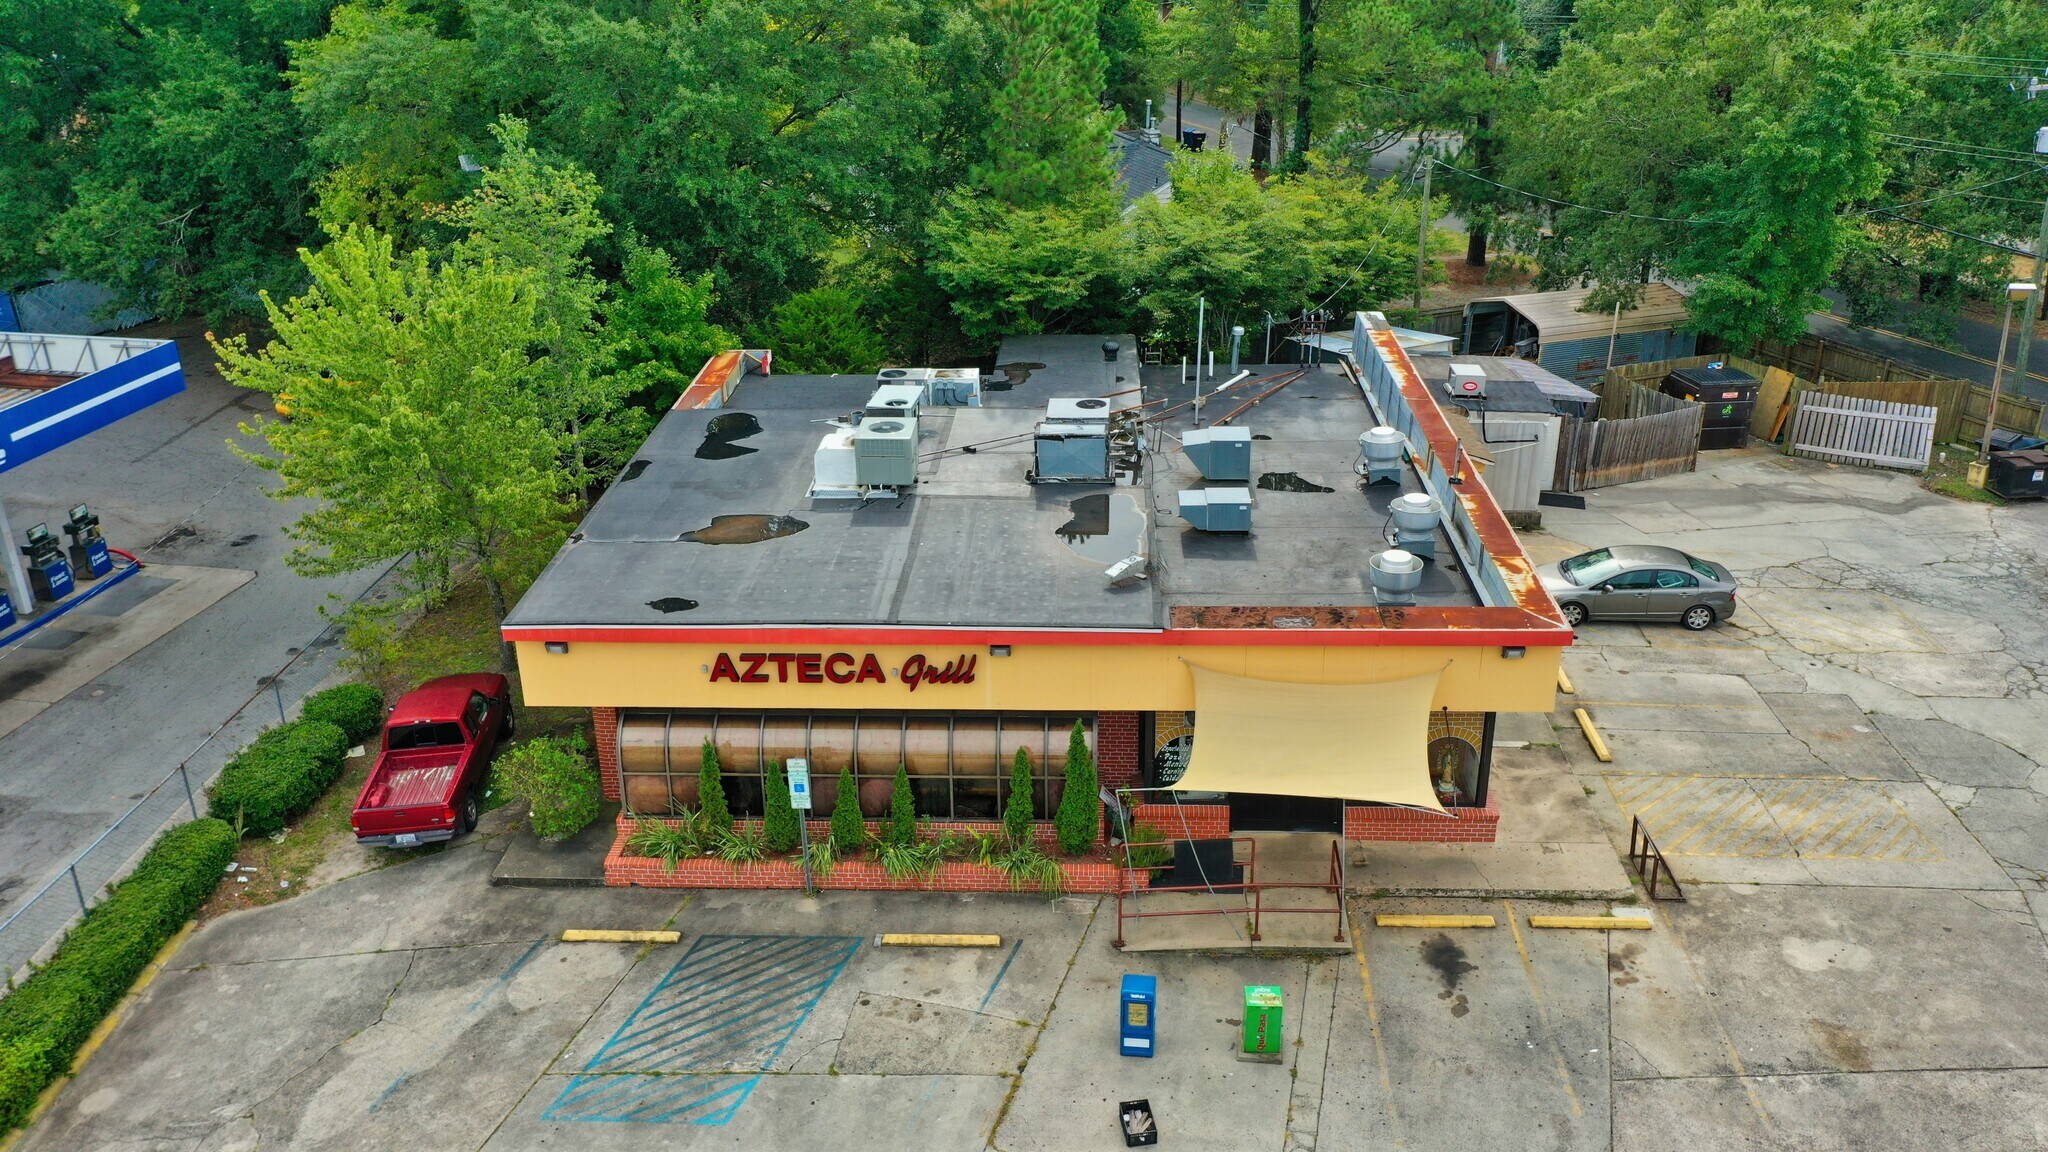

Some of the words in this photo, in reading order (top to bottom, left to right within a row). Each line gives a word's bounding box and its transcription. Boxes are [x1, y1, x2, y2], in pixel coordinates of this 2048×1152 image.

[91, 551, 105, 562] Fast
[93, 555, 108, 567] Lane
[51, 571, 66, 583] Fast
[52, 575, 69, 588] Lane
[709, 652, 886, 684] AZTECA
[900, 654, 977, 692] Grill
[1258, 1013, 1267, 1033] Pasa
